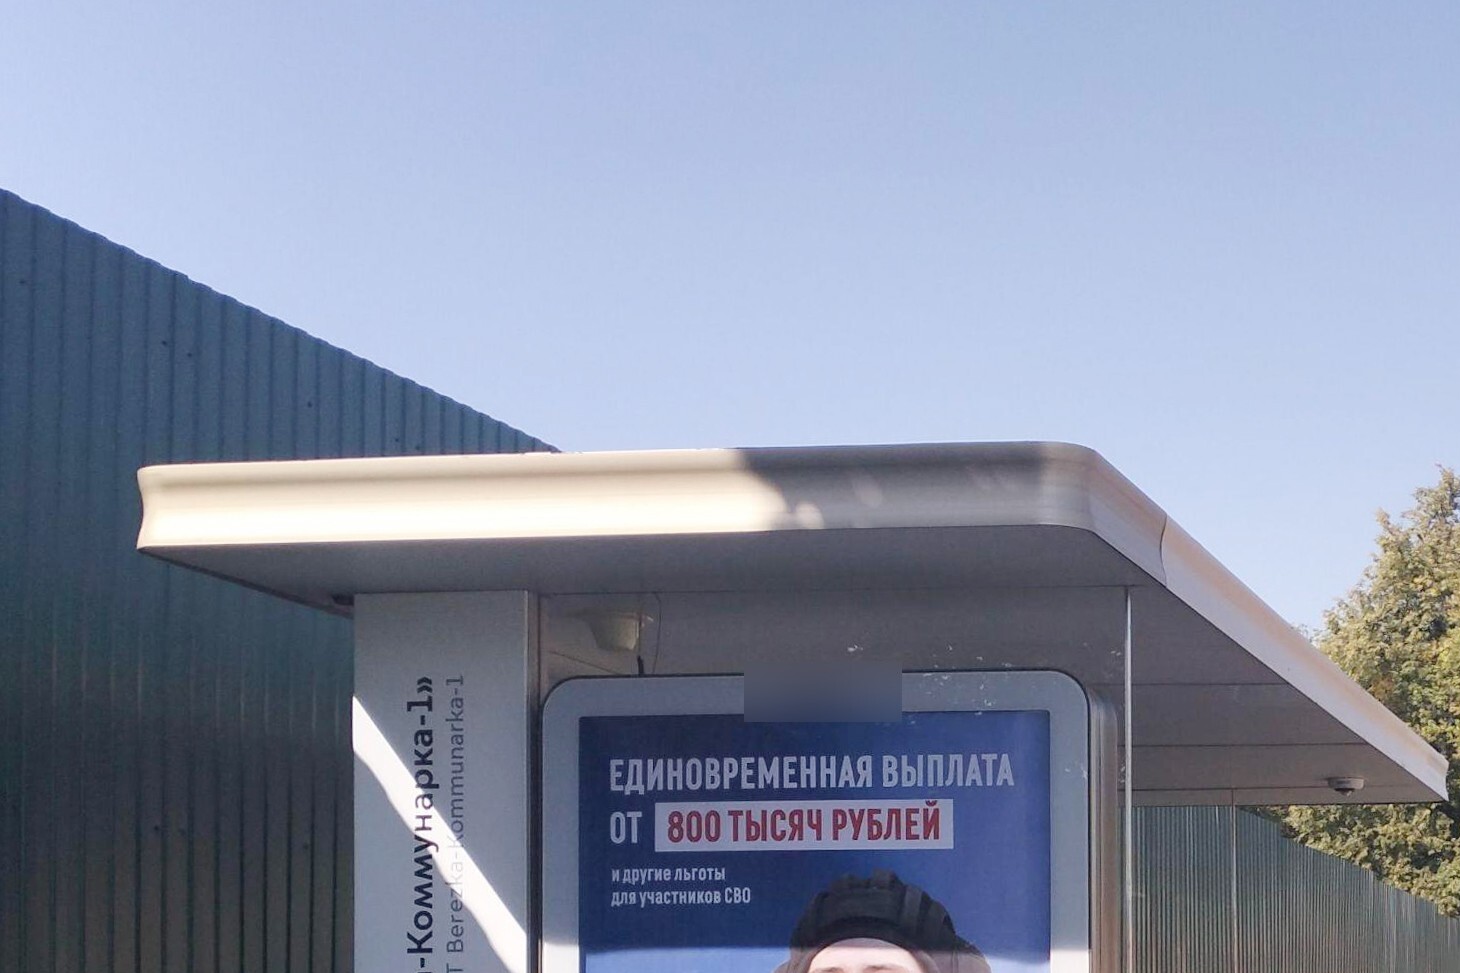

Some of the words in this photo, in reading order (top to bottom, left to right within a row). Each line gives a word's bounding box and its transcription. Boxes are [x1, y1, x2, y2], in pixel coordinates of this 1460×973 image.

[609, 755, 873, 795] ЕДИНОВРЕМЕННАЯ
[882, 753, 1015, 788] ВЫПЛАТА
[610, 811, 642, 844] ОТ
[667, 810, 721, 843] 800
[727, 808, 822, 842] ТЫСЯЧ
[832, 799, 940, 841] РУБЛЕЙ
[611, 869, 620, 882] и
[622, 868, 671, 886] другие
[673, 867, 726, 881] льготы
[611, 891, 636, 908] для
[639, 889, 721, 908] участников
[724, 887, 751, 904] СВО
